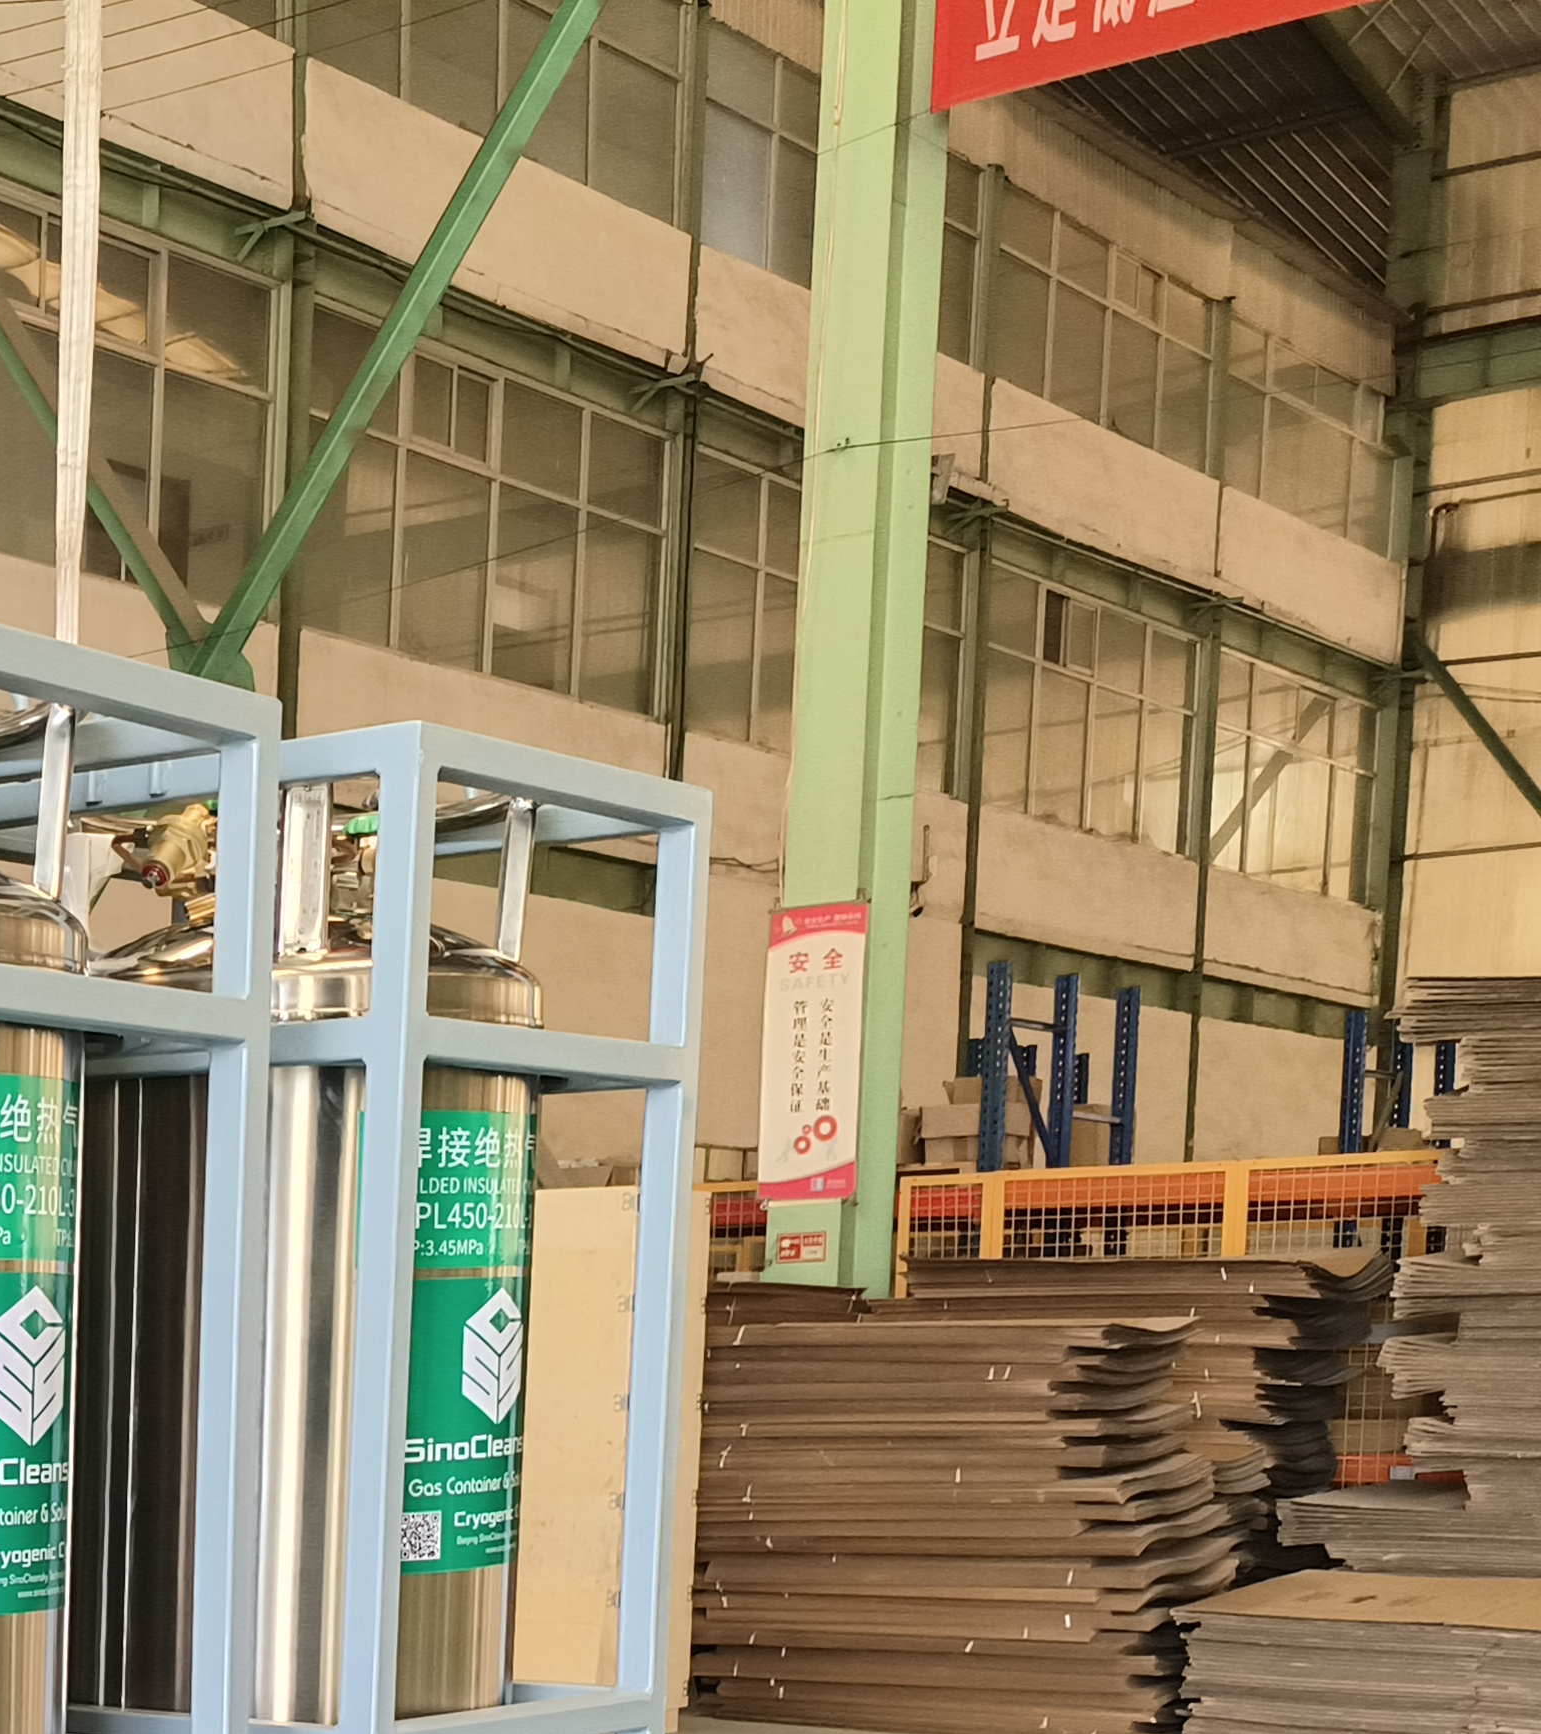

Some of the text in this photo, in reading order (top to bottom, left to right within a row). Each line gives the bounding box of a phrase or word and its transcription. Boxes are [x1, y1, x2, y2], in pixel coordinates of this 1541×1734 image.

[789, 948, 843, 974] 安全
[779, 972, 850, 992] SAFETY
[815, 998, 834, 1112] 安全是生产基础
[408, 1478, 442, 1497] Gas
[446, 1475, 501, 1495] Container
[41, 1502, 48, 1524] &
